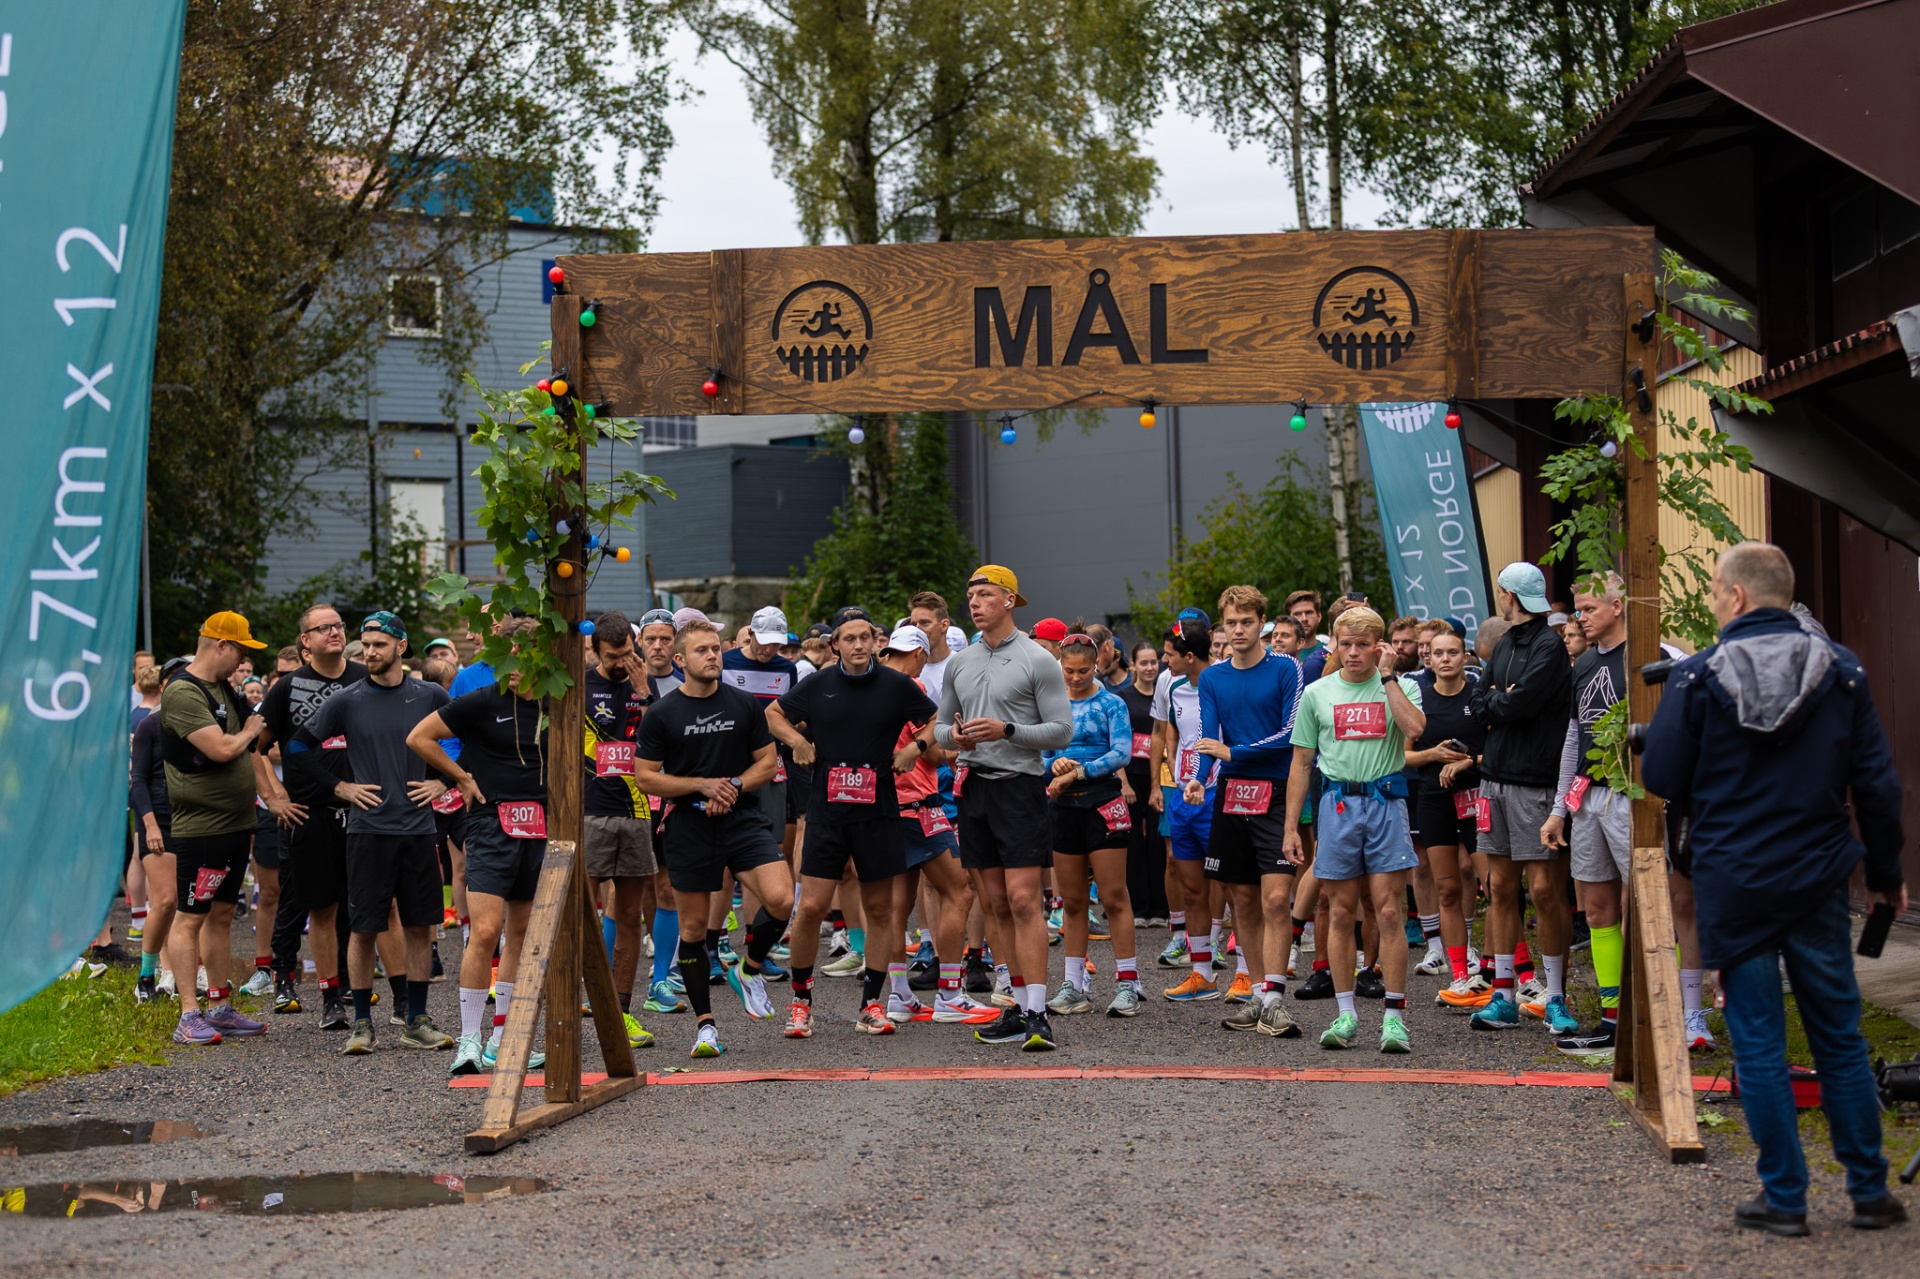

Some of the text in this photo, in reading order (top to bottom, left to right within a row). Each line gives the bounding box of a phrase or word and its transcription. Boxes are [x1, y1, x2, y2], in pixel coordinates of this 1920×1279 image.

[974, 268, 1208, 368] MÅL
[24, 222, 128, 722] 6,7km x 12
[291, 682, 343, 726] adidas
[1346, 707, 1370, 723] 271
[608, 746, 631, 761] 312
[840, 773, 863, 787] 189
[1236, 784, 1259, 800] 327
[511, 806, 535, 823] 307
